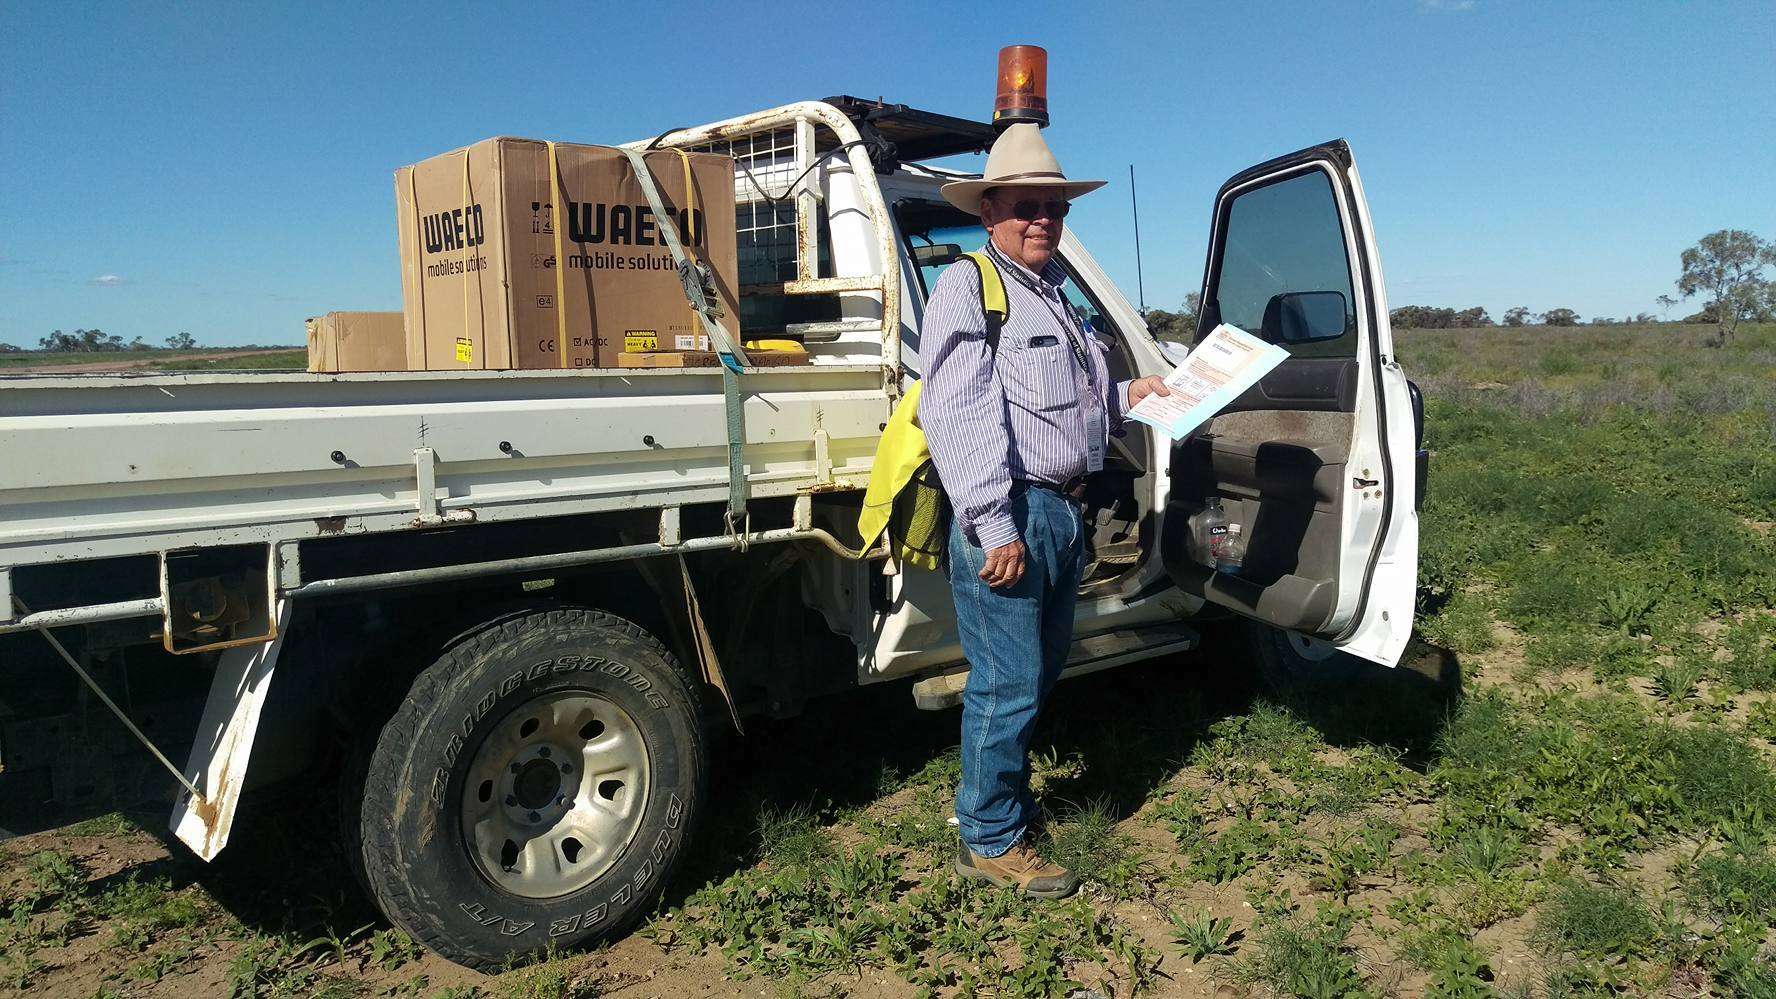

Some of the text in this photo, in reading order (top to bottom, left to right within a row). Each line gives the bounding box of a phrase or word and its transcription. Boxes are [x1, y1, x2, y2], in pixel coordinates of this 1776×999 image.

[423, 204, 484, 254] WAECO
[427, 254, 487, 278] mobile soutions
[569, 252, 704, 271] mobile soluti
[432, 655, 670, 809] BRIDGESTONE
[549, 793, 683, 937] DUELER
[458, 902, 536, 936] A/T
